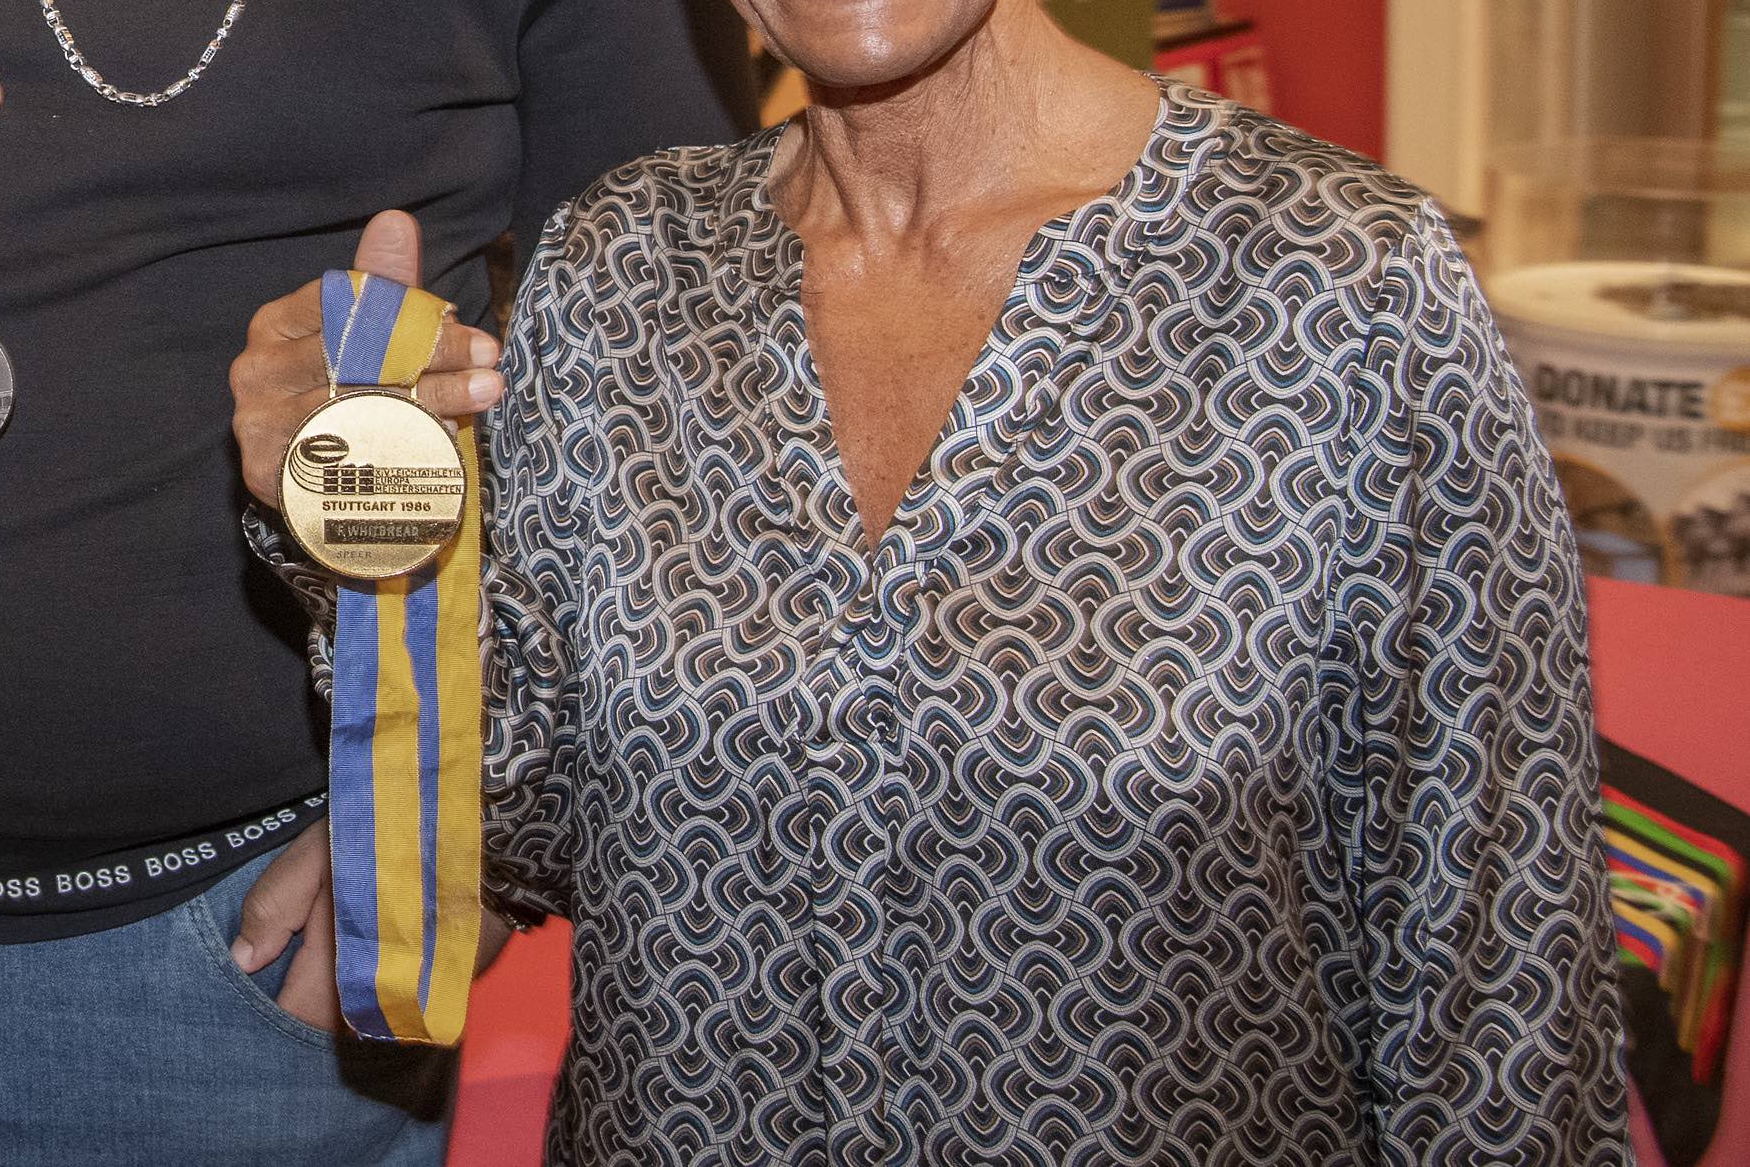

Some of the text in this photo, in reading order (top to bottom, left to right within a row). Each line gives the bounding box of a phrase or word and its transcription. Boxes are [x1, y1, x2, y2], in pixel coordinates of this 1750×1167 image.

[1534, 362, 1704, 419] DONATE
[375, 477, 410, 485] EUROPA
[375, 484, 462, 494] MEISTERSCHAFTEN
[322, 500, 432, 512] STUTTGART 1986
[336, 550, 372, 559] SPEER
[56, 865, 131, 894] BOSS
[144, 842, 217, 877] BOSS
[225, 808, 297, 848] BOSS
